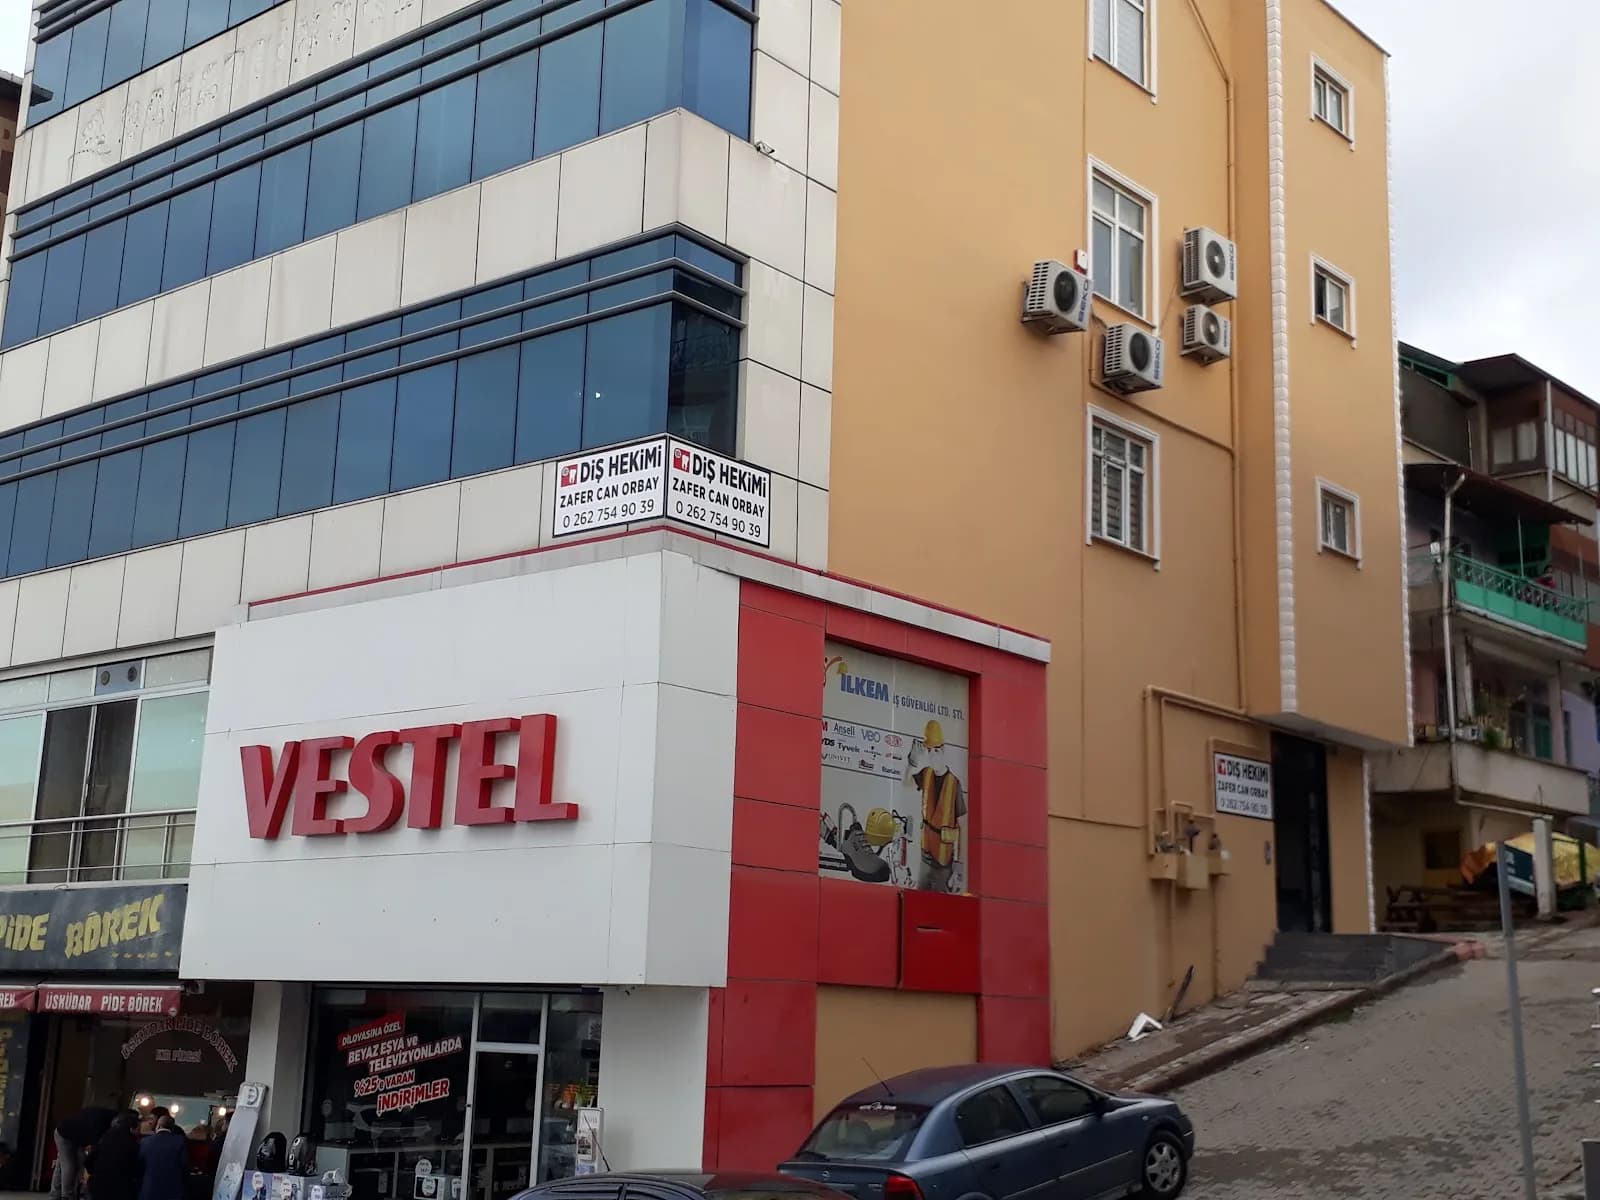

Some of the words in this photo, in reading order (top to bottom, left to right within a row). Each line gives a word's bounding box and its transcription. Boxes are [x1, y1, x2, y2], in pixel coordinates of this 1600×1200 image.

[1077, 279, 1089, 323] BEKO
[1153, 339, 1162, 380] BEKO
[580, 458, 604, 484] DİŞ
[608, 445, 662, 477] HEKİMİ
[692, 454, 716, 484] DİŞ
[719, 464, 767, 498] HEKİMİ
[560, 492, 593, 509] ZAFER
[596, 486, 619, 501] CAN
[622, 476, 660, 496] ORBAY
[672, 477, 705, 500] ZAFER
[708, 486, 729, 507] CAN
[732, 494, 765, 518] ORBAY
[563, 515, 570, 528] 0
[573, 511, 594, 527] 262
[597, 506, 618, 522] 754
[621, 502, 635, 517] 90
[640, 498, 655, 513] 39
[675, 501, 684, 514] 0
[686, 503, 707, 522] 262
[709, 511, 728, 528] 754
[732, 516, 746, 533] 90
[748, 522, 761, 537] 39
[833, 722, 855, 736] Ansell
[239, 713, 579, 840] VESTEL
[64, 893, 165, 959] BÖREK
[45, 992, 92, 1011] ÜSKÜDAR
[100, 993, 126, 1012] PİDE
[128, 995, 163, 1013] BÖREK
[342, 1026, 383, 1046] DİLOVASINA
[383, 1021, 402, 1035] ÖZEL
[348, 1043, 380, 1064] BEYAZ
[380, 1038, 405, 1054] EŞYA
[406, 1035, 419, 1047] ve
[369, 1036, 462, 1073] TELEVİZYONLARDA
[376, 1078, 450, 1117] İNDİRİMLER
[385, 1069, 416, 1090] VARAN
